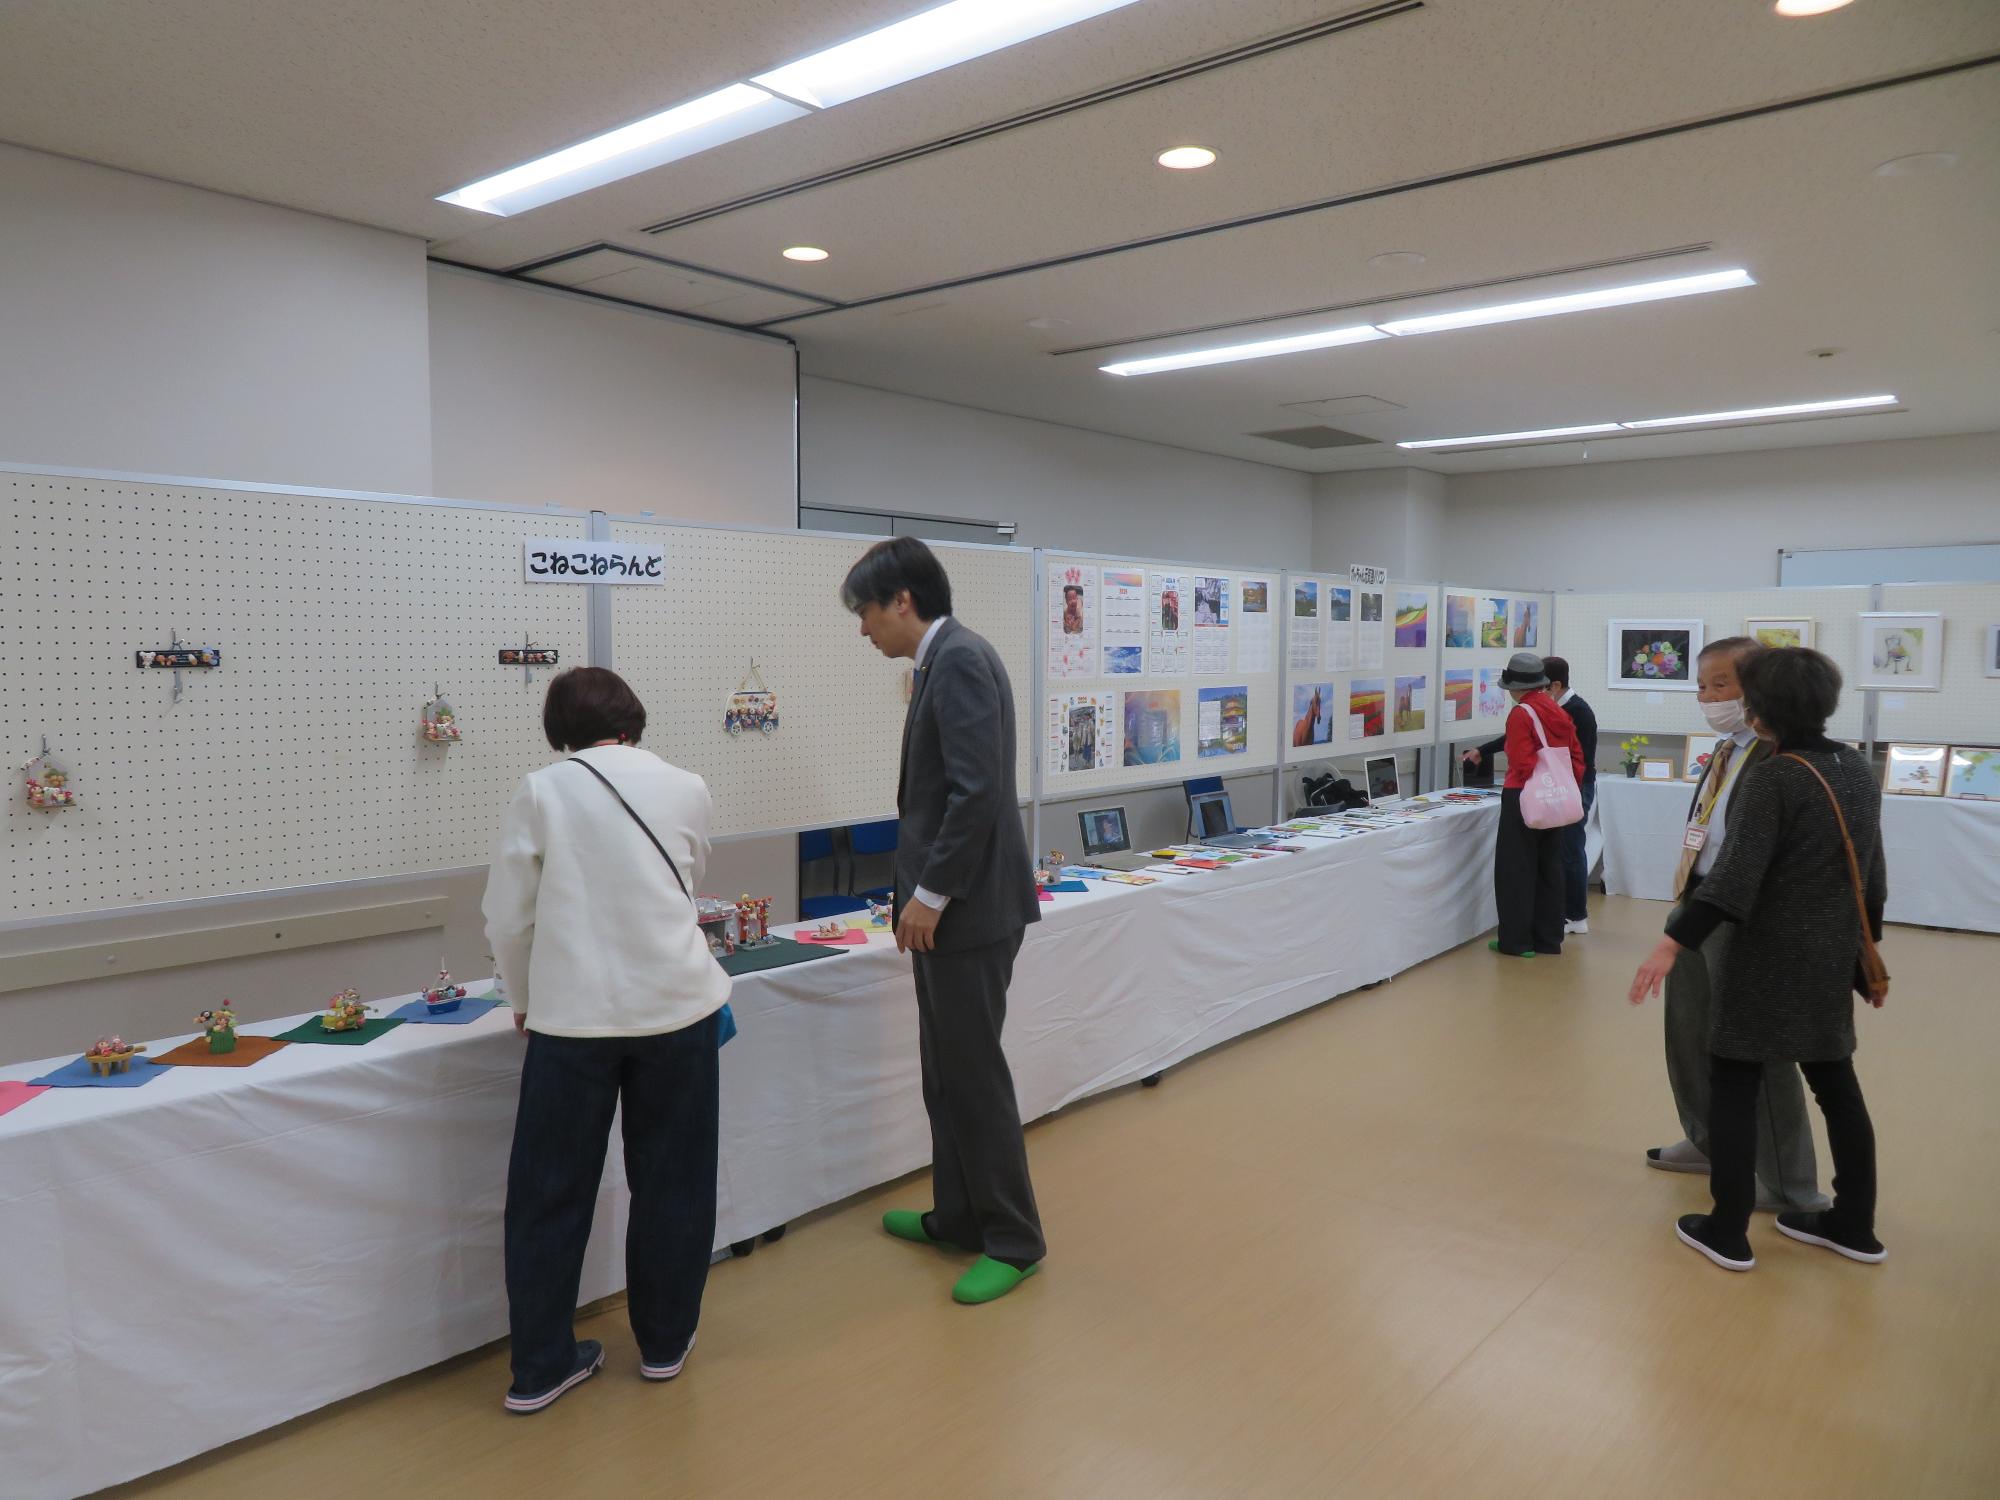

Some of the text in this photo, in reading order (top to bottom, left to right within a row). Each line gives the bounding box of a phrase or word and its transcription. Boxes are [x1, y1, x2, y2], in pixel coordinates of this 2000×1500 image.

[530, 552, 662, 577] こねこねらんど
